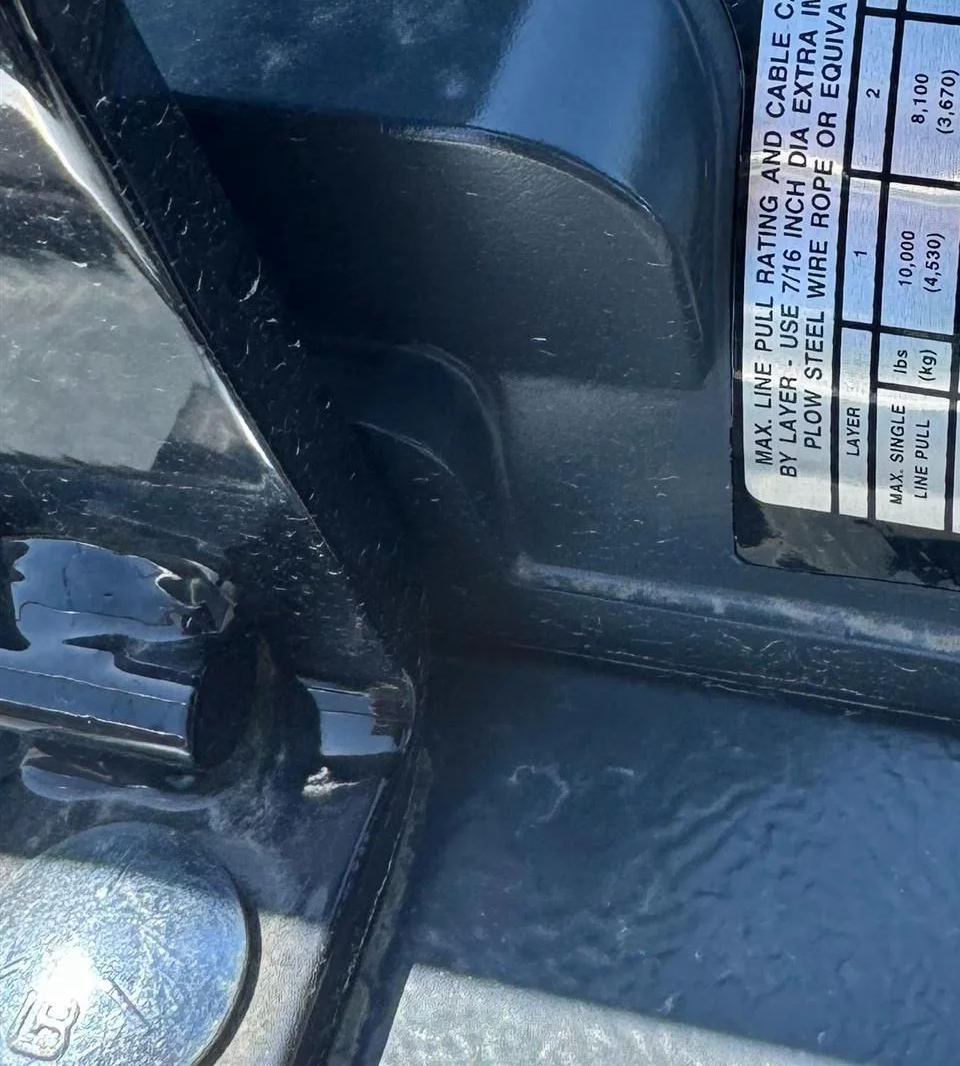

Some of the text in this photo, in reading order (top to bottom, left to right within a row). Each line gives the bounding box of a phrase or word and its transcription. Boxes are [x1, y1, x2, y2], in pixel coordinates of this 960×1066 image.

[766, 32, 791, 119] CABLE
[793, 29, 818, 115] EXTRA
[910, 73, 930, 124] 8,100
[814, 110, 837, 149] OR
[936, 69, 960, 134] (3,670)
[761, 130, 783, 184] AND
[787, 126, 810, 172] DIA
[784, 179, 806, 238] INCH
[810, 159, 834, 231] ROPE
[756, 195, 778, 285] RATING
[899, 230, 916, 287] 10,000
[924, 232, 946, 293] (4,530)
[782, 249, 802, 295] 7/16
[805, 239, 829, 303] WIRE
[846, 406, 862, 456] LAYER
[854, 250, 868, 258] 1
[866, 87, 881, 98] 2
[755, 295, 775, 353] PULL
[780, 304, 799, 352] USE
[804, 310, 825, 381] STEEL
[753, 362, 772, 410] LINE
[893, 349, 908, 375] lbs
[918, 348, 938, 383] (kg)
[779, 376, 798, 447] LAYER
[804, 389, 823, 450] PLOW
[890, 405, 906, 463] SINGLE
[916, 418, 930, 460] PULL
[755, 419, 774, 466] MAX.
[779, 453, 798, 478] BY
[889, 463, 905, 505] MAX.
[915, 460, 929, 499] LINE
